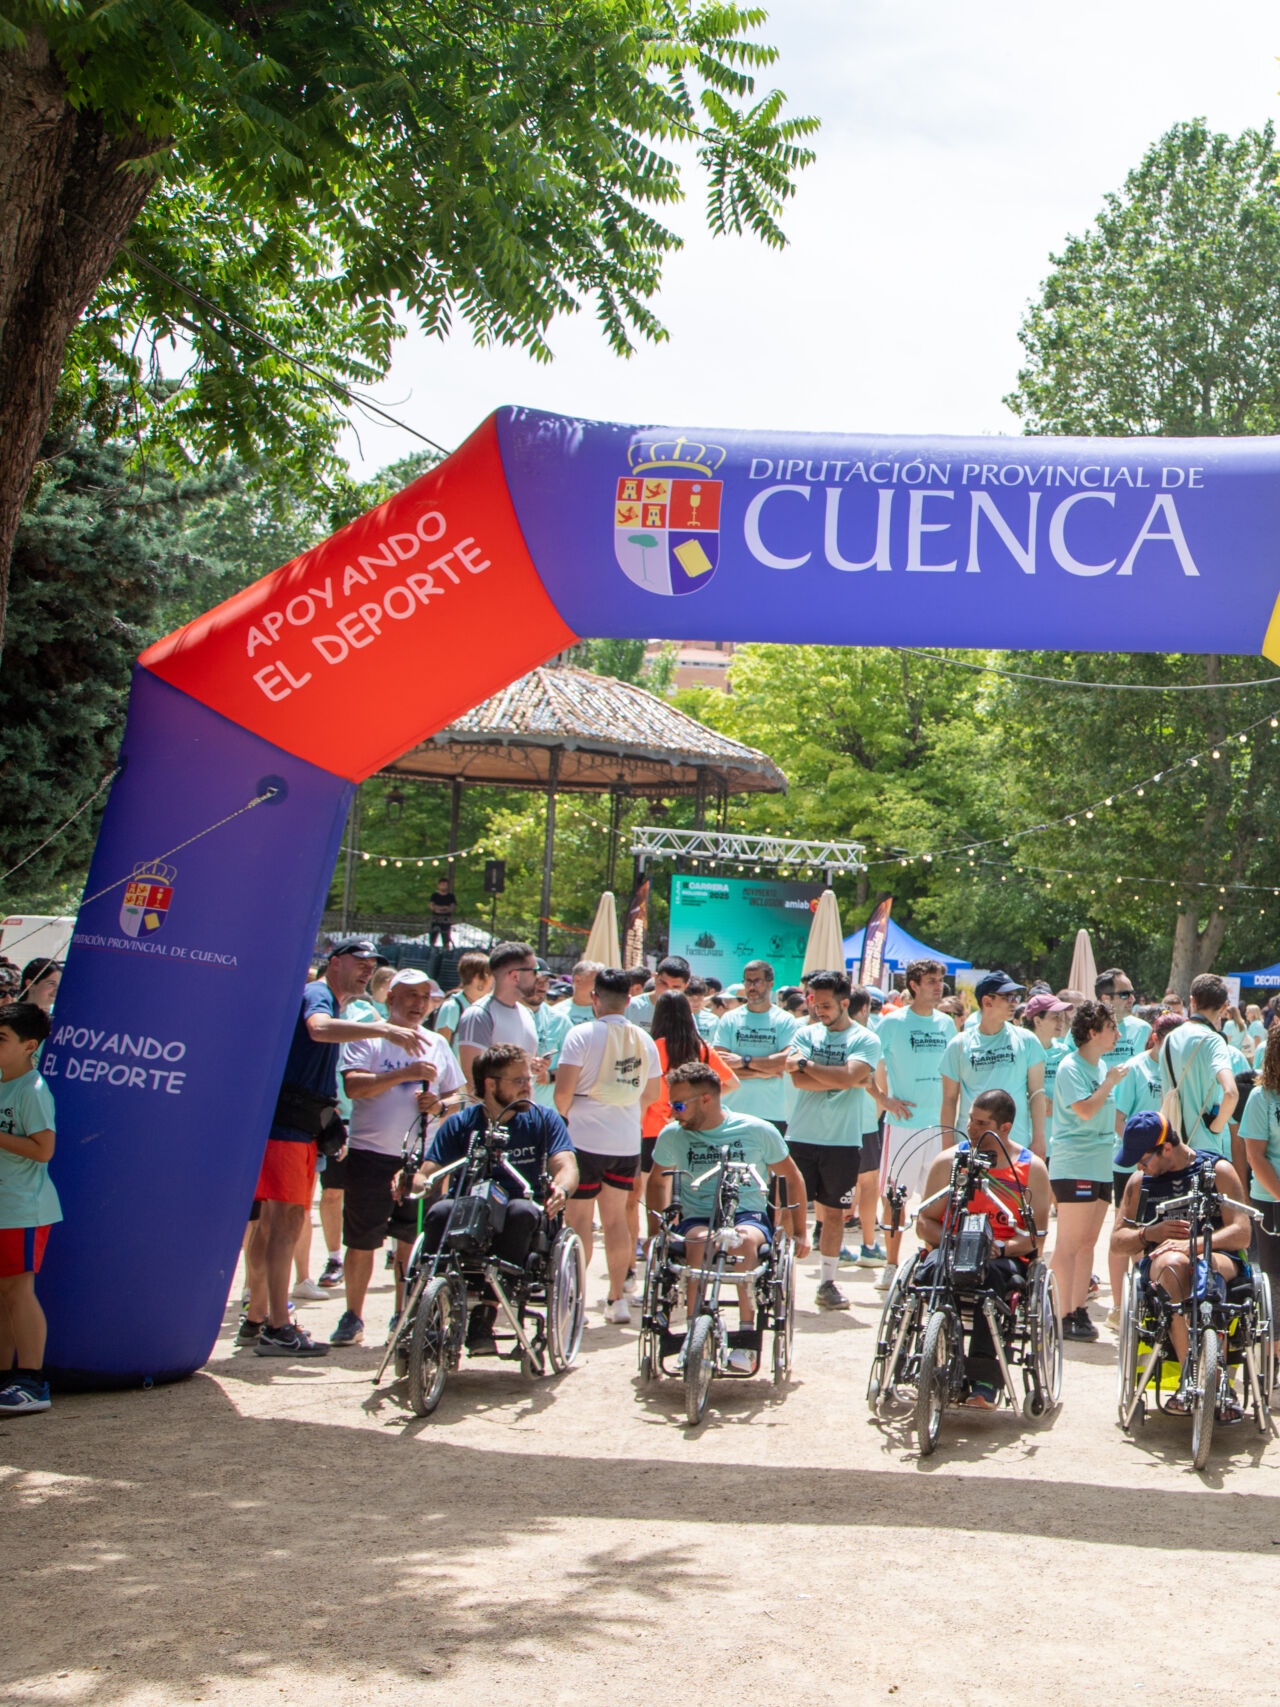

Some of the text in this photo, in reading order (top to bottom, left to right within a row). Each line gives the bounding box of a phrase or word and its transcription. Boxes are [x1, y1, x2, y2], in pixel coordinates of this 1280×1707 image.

[749, 458, 1205, 489] DIPUTACIÓN PROVINCIAL DE
[744, 484, 1201, 577] CUENCA
[247, 511, 447, 657] APOYANDO
[253, 537, 491, 702] EL DEPORTE
[784, 899, 810, 910] amiab
[107, 936, 169, 956] PROVINCIAL
[170, 946, 187, 958] DE
[190, 949, 238, 966] CUENCA
[53, 1025, 186, 1062] APOYANDO
[43, 1053, 187, 1094] EL DEPORTE
